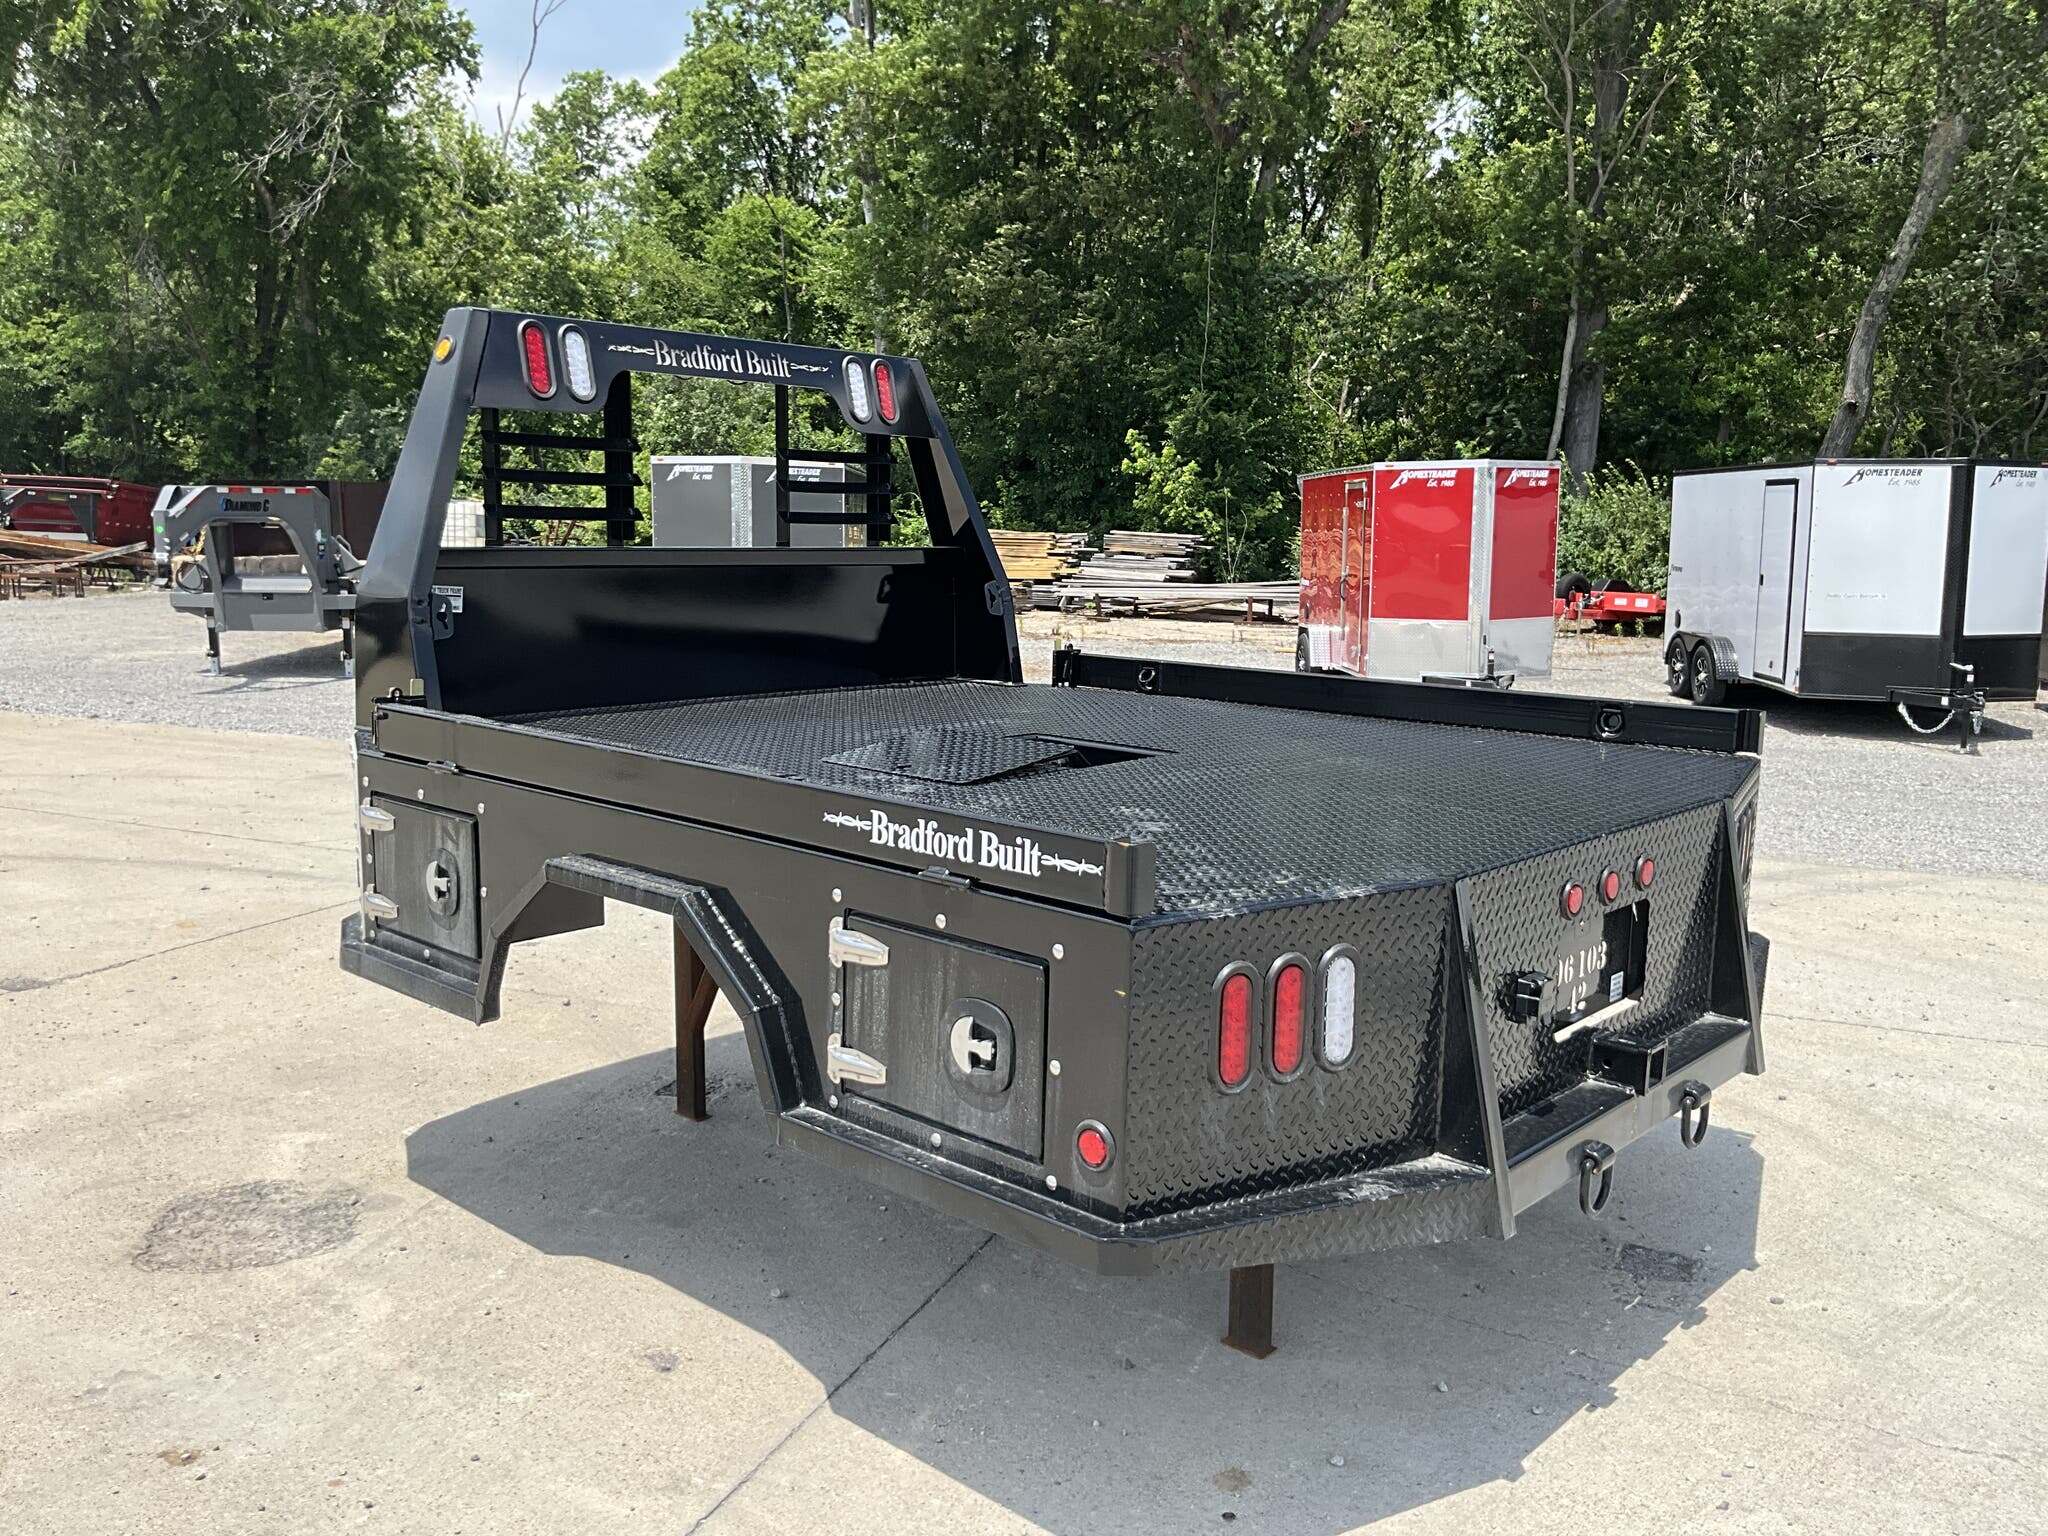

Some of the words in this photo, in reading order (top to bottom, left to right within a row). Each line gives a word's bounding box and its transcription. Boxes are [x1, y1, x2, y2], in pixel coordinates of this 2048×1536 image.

[653, 340, 743, 374] Bradford
[747, 350, 791, 378] Built
[1389, 469, 1458, 489] HOMESTEADER
[1841, 468, 1923, 487] HOMESTEADER
[223, 498, 261, 512] DIAMOND
[870, 809, 973, 863] Bradford
[978, 829, 1041, 877] Built
[1579, 941, 1607, 978] 103
